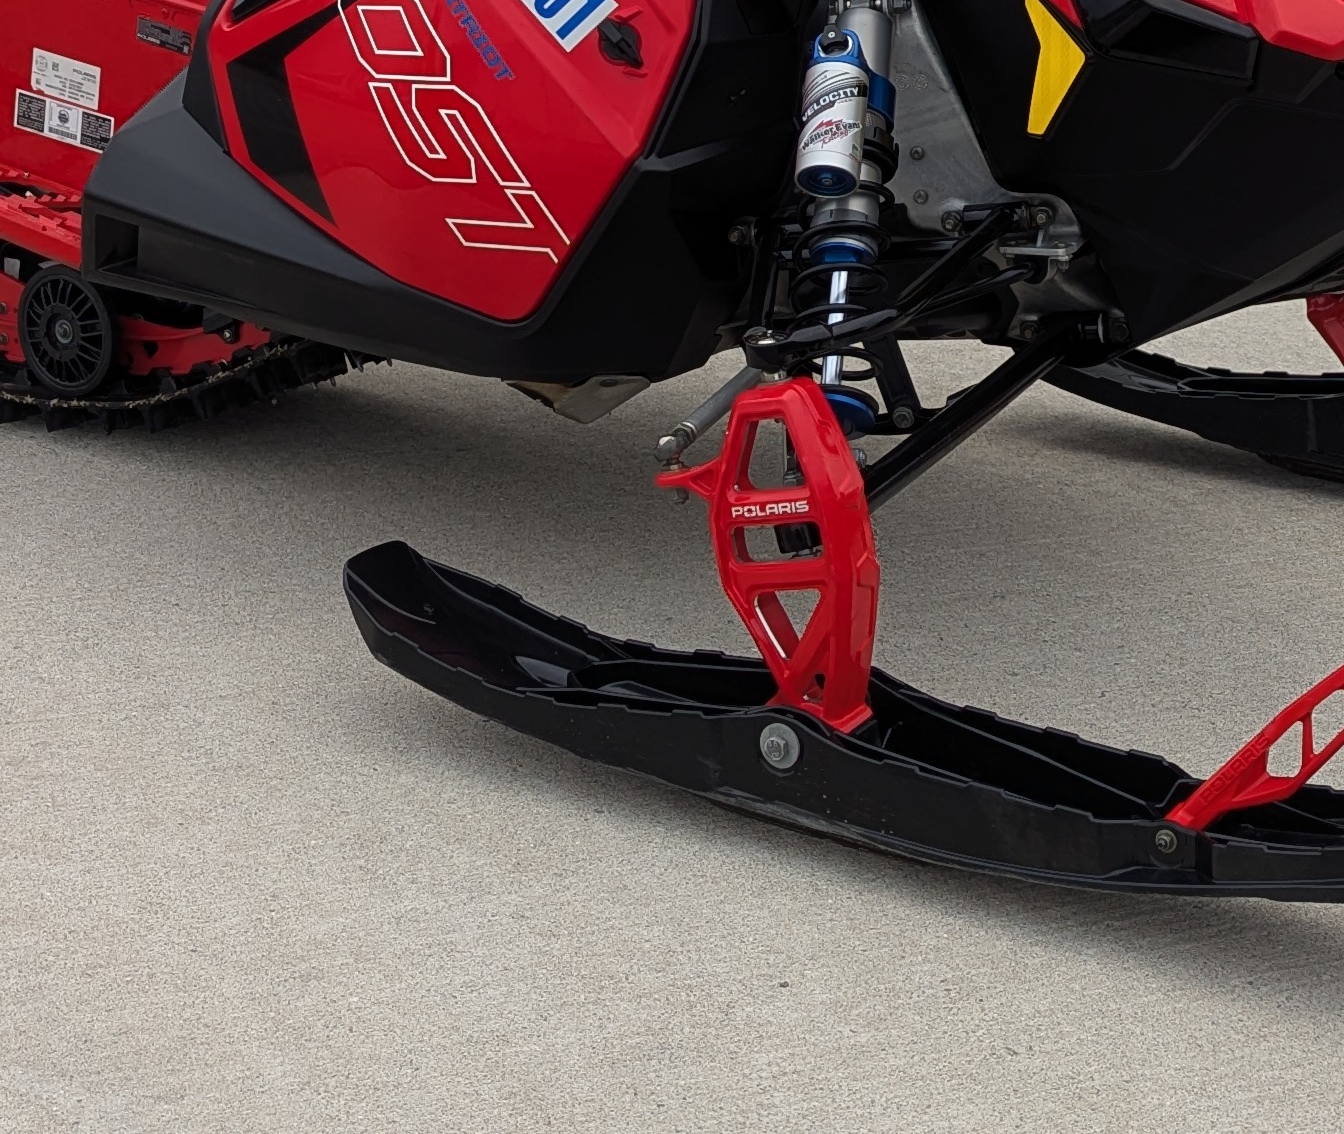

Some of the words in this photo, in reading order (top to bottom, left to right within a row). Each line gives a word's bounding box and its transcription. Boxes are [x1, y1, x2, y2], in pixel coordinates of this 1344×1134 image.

[802, 87, 859, 122] VELOCITY
[731, 500, 810, 519] POLARIS
[1199, 733, 1271, 805] POLARIS
